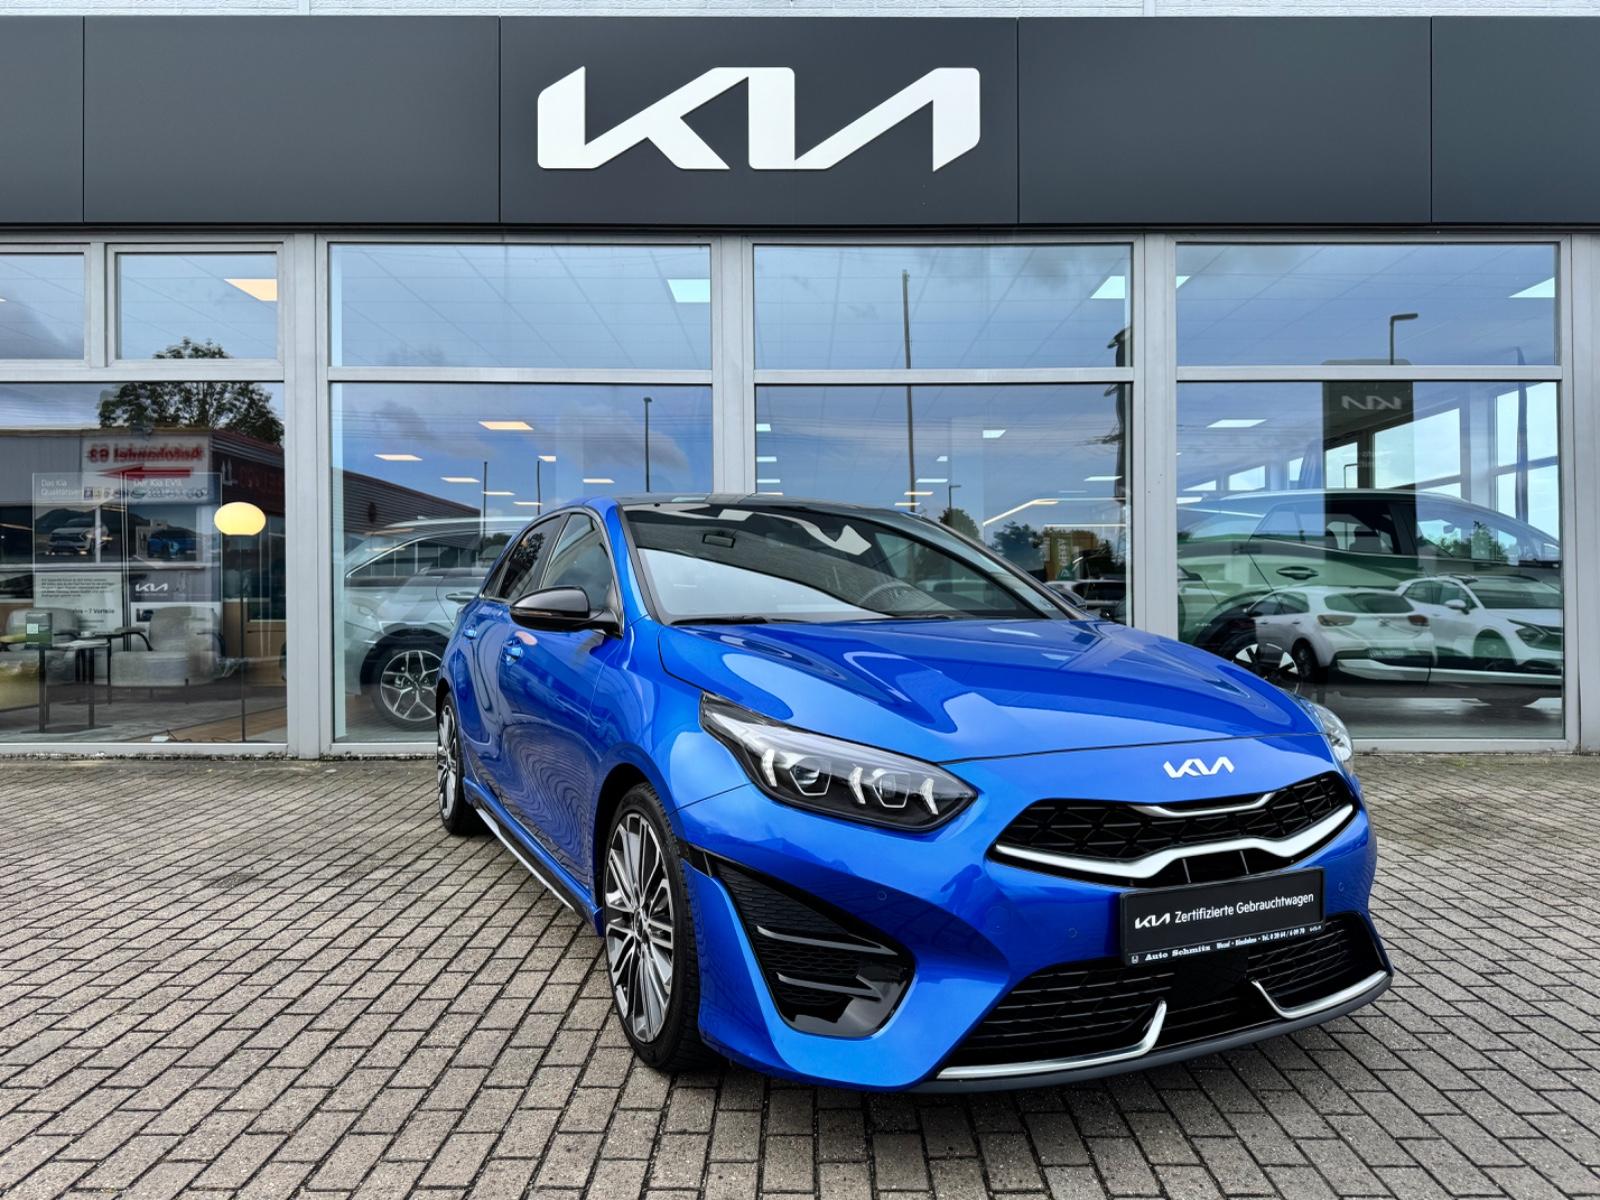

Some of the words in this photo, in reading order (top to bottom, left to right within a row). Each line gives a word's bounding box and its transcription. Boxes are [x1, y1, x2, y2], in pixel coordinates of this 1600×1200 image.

[537, 65, 981, 172] KIA
[1163, 756, 1235, 778] KIA
[1134, 912, 1171, 930] KIA
[1174, 905, 1235, 924] Zertifizierte
[1236, 893, 1314, 914] Gebrauchtwagen
[1145, 952, 1168, 961] Auto
[1172, 945, 1211, 957] Schmitz
